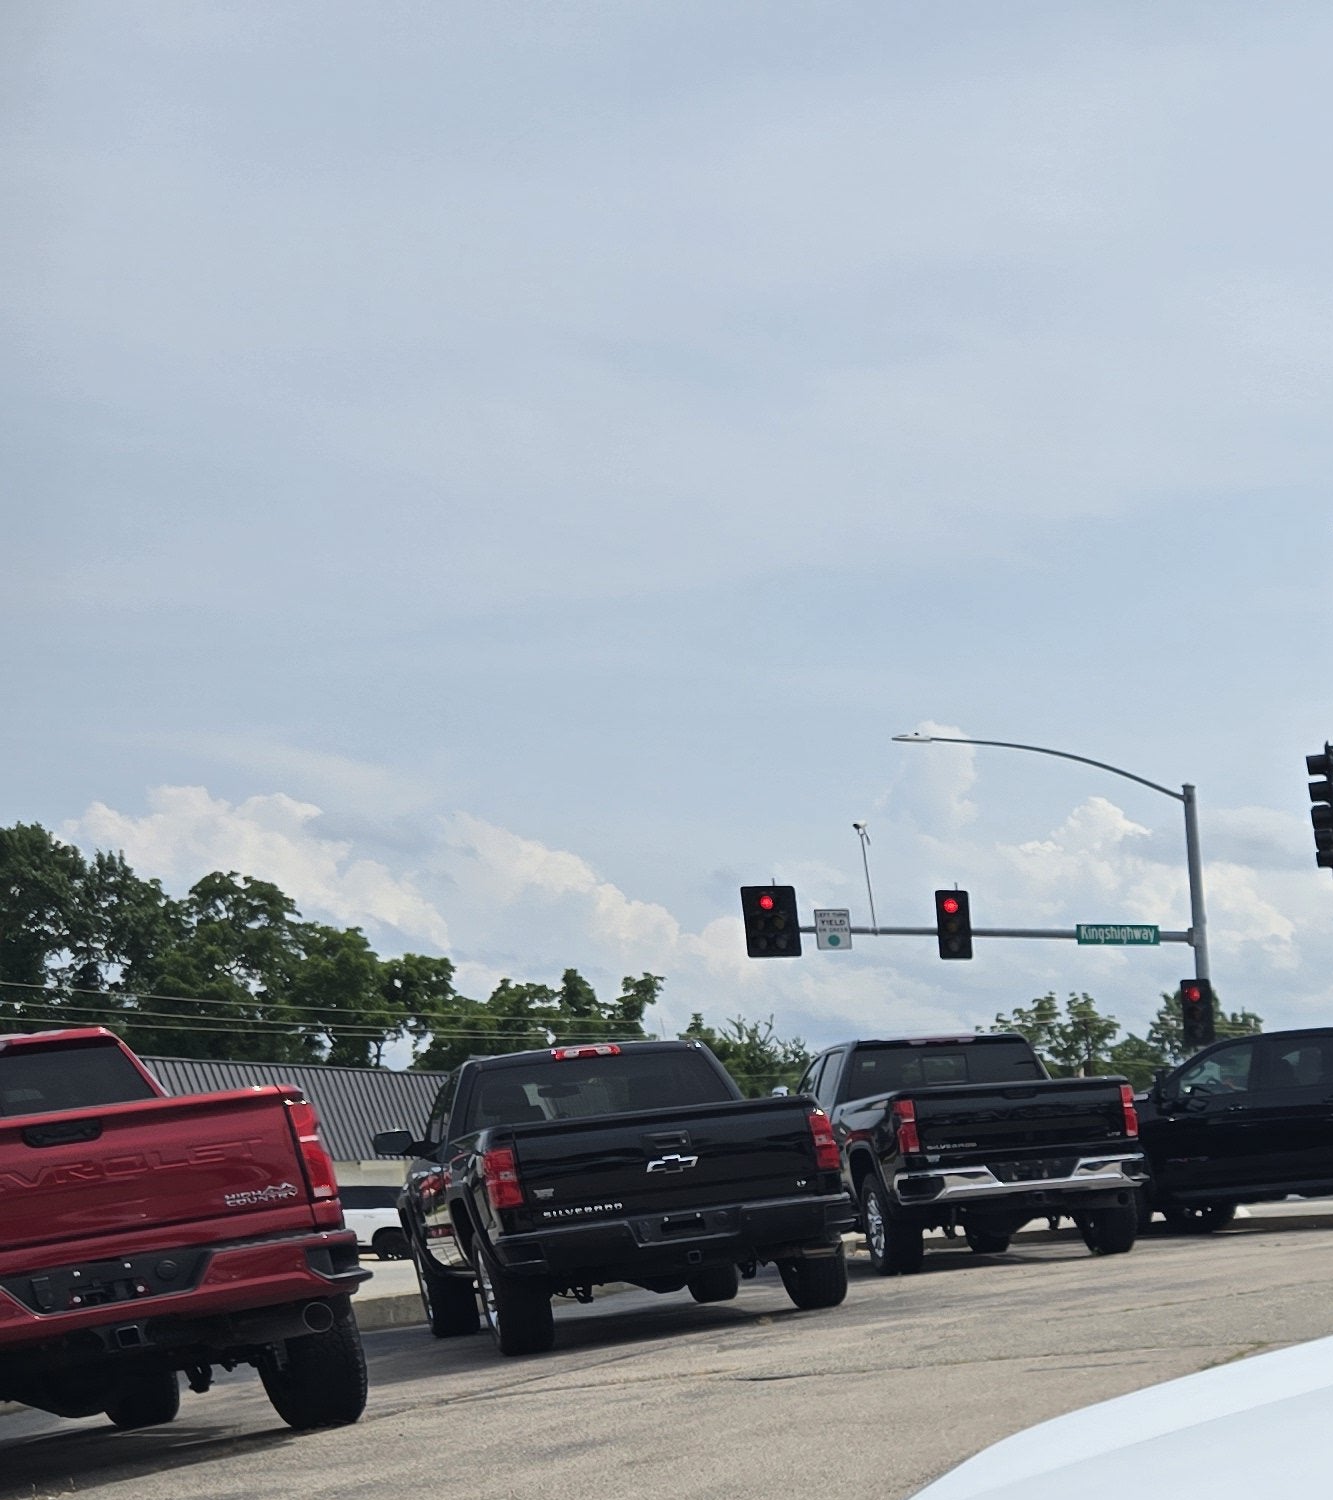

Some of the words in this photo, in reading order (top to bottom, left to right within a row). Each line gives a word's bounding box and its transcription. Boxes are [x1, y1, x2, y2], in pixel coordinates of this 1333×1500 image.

[1081, 926, 1156, 944] Kingshighway
[0, 1138, 263, 1192] VROLET
[543, 1202, 623, 1218] SILVERADO
